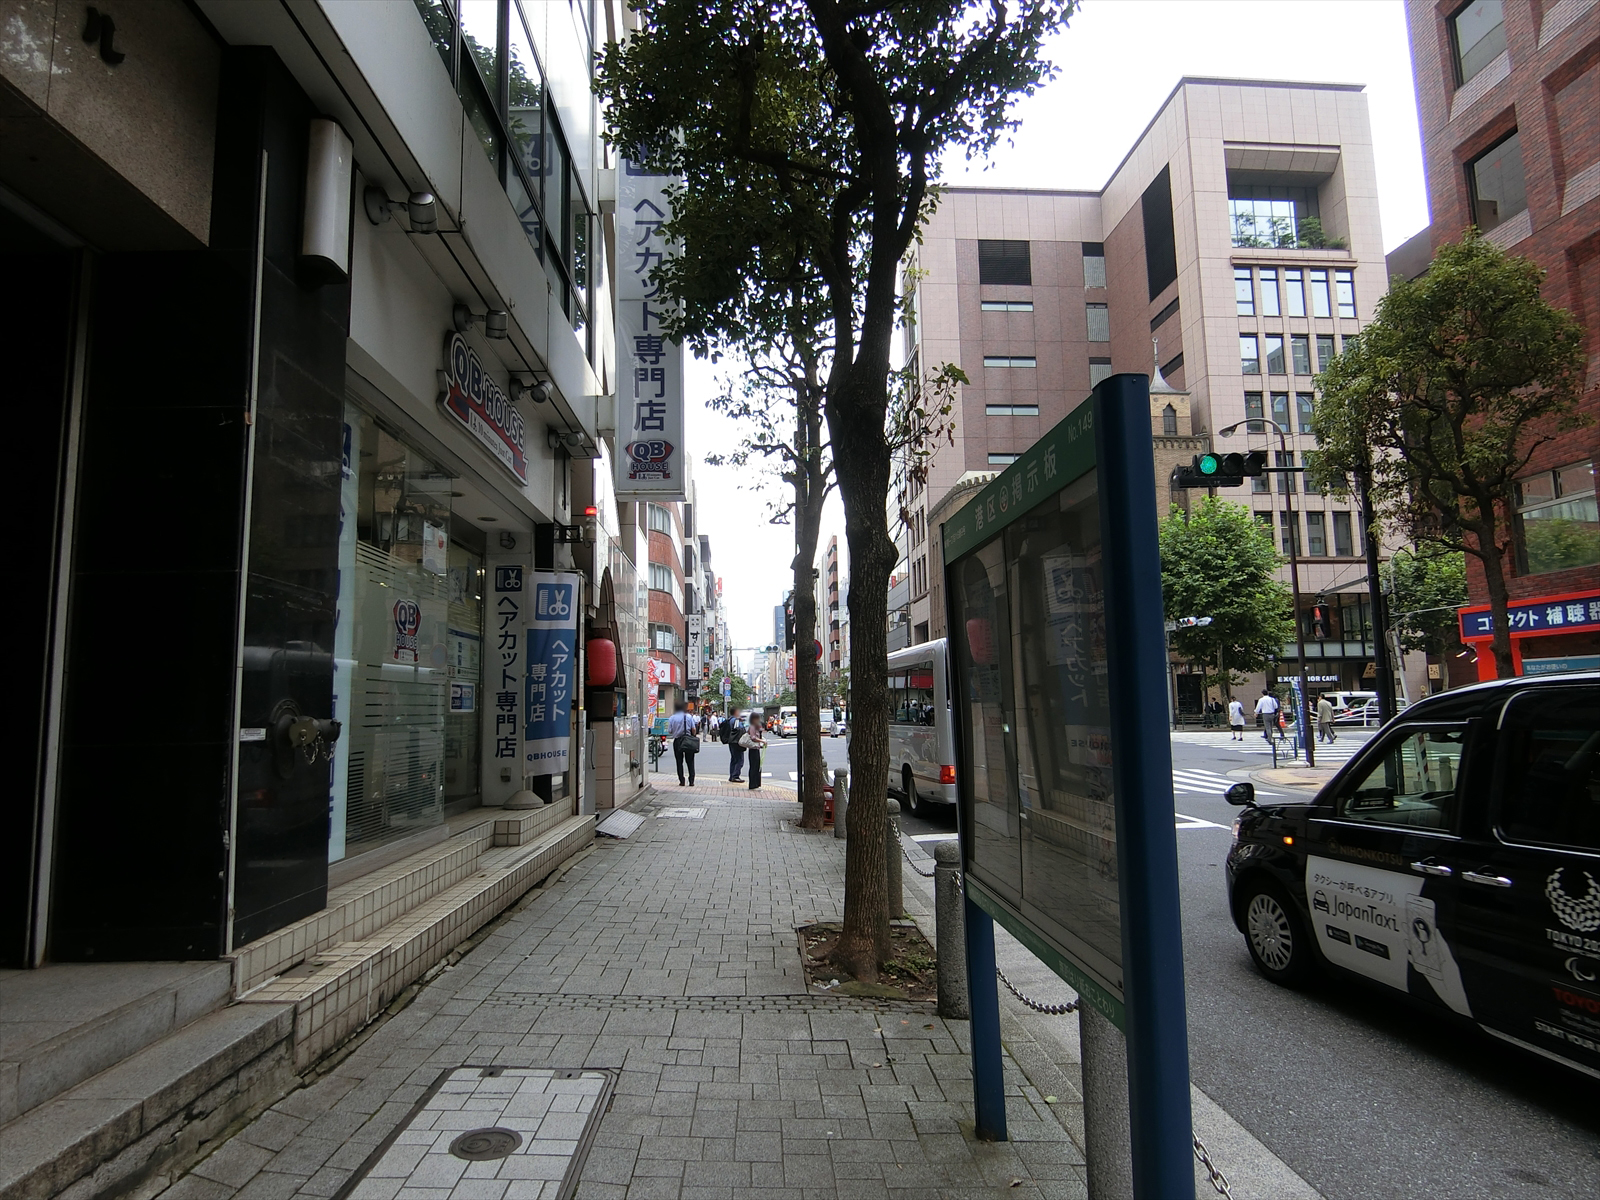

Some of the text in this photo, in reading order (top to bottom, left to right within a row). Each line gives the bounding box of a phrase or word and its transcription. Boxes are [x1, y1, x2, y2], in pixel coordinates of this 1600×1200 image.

[633, 198, 667, 432] ヘアカット専門店
[454, 342, 525, 452] QB HOUSE
[632, 441, 667, 461] QB
[632, 461, 669, 471] HOUSE
[974, 444, 1058, 532] 港区 掲示板
[396, 600, 417, 634] QB
[1477, 610, 1539, 631] コタクト
[395, 634, 419, 650] HOUSE
[495, 596, 519, 759] ヘアカット専門店
[550, 639, 570, 722] ヘアカット
[1277, 675, 1321, 683] EXCEIOR
[529, 662, 548, 723] 専門店
[526, 749, 568, 762] QBHOUSE
[1340, 845, 1404, 866] NIHONKOTSU
[1332, 894, 1400, 933] JapanTaxi
[1545, 928, 1582, 948] TOKYO
[1552, 987, 1600, 1013] TOYO
